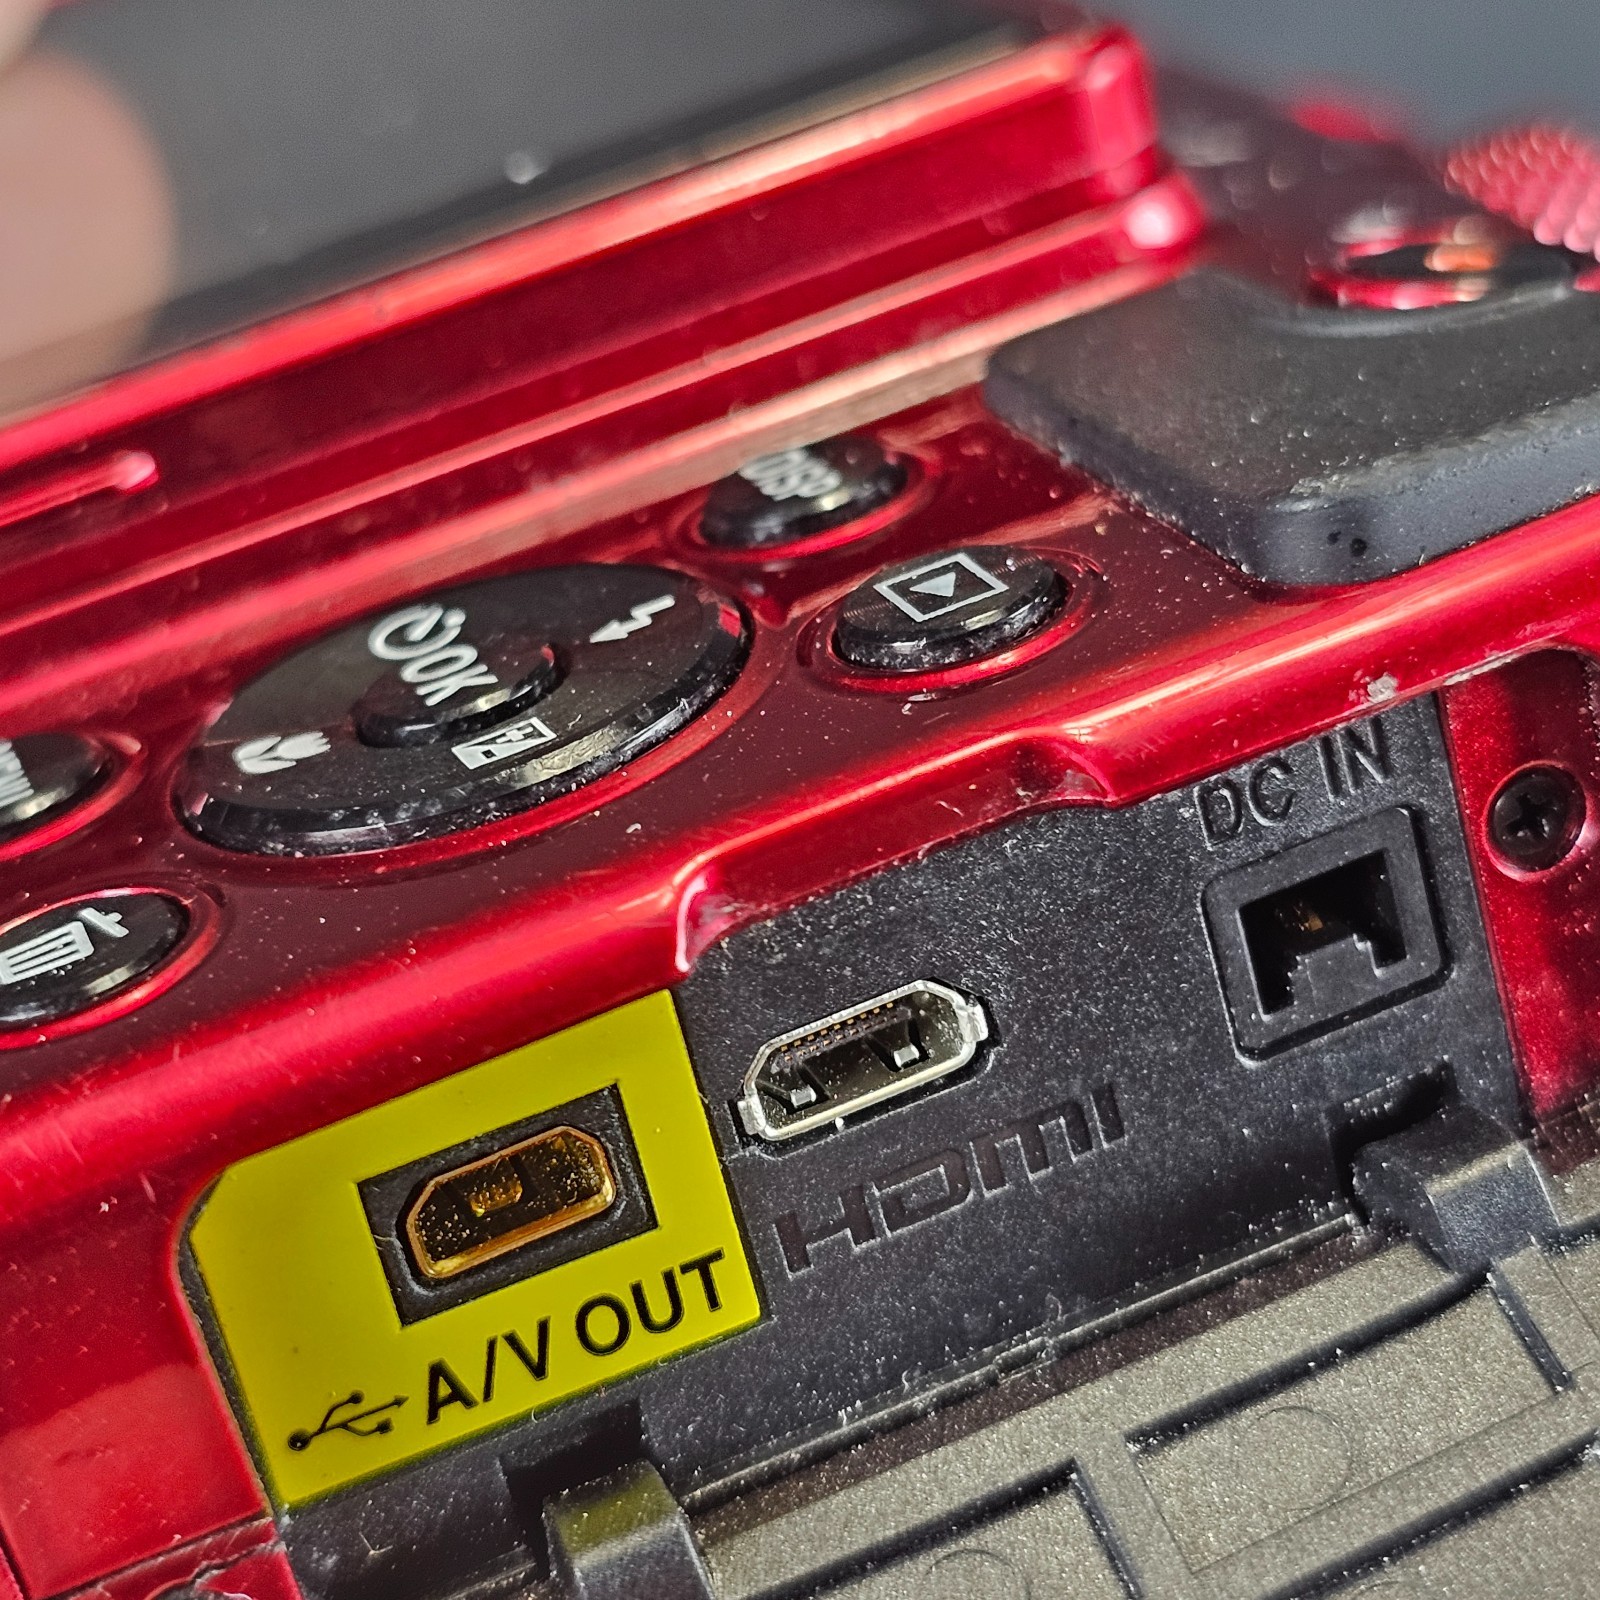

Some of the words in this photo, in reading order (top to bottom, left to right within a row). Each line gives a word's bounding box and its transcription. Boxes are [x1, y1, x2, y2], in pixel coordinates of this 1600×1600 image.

[400, 643, 499, 707] OK
[1193, 756, 1298, 851] DC
[1312, 715, 1391, 804] IN
[426, 1315, 551, 1426] A/V
[574, 1246, 725, 1356] OUT
